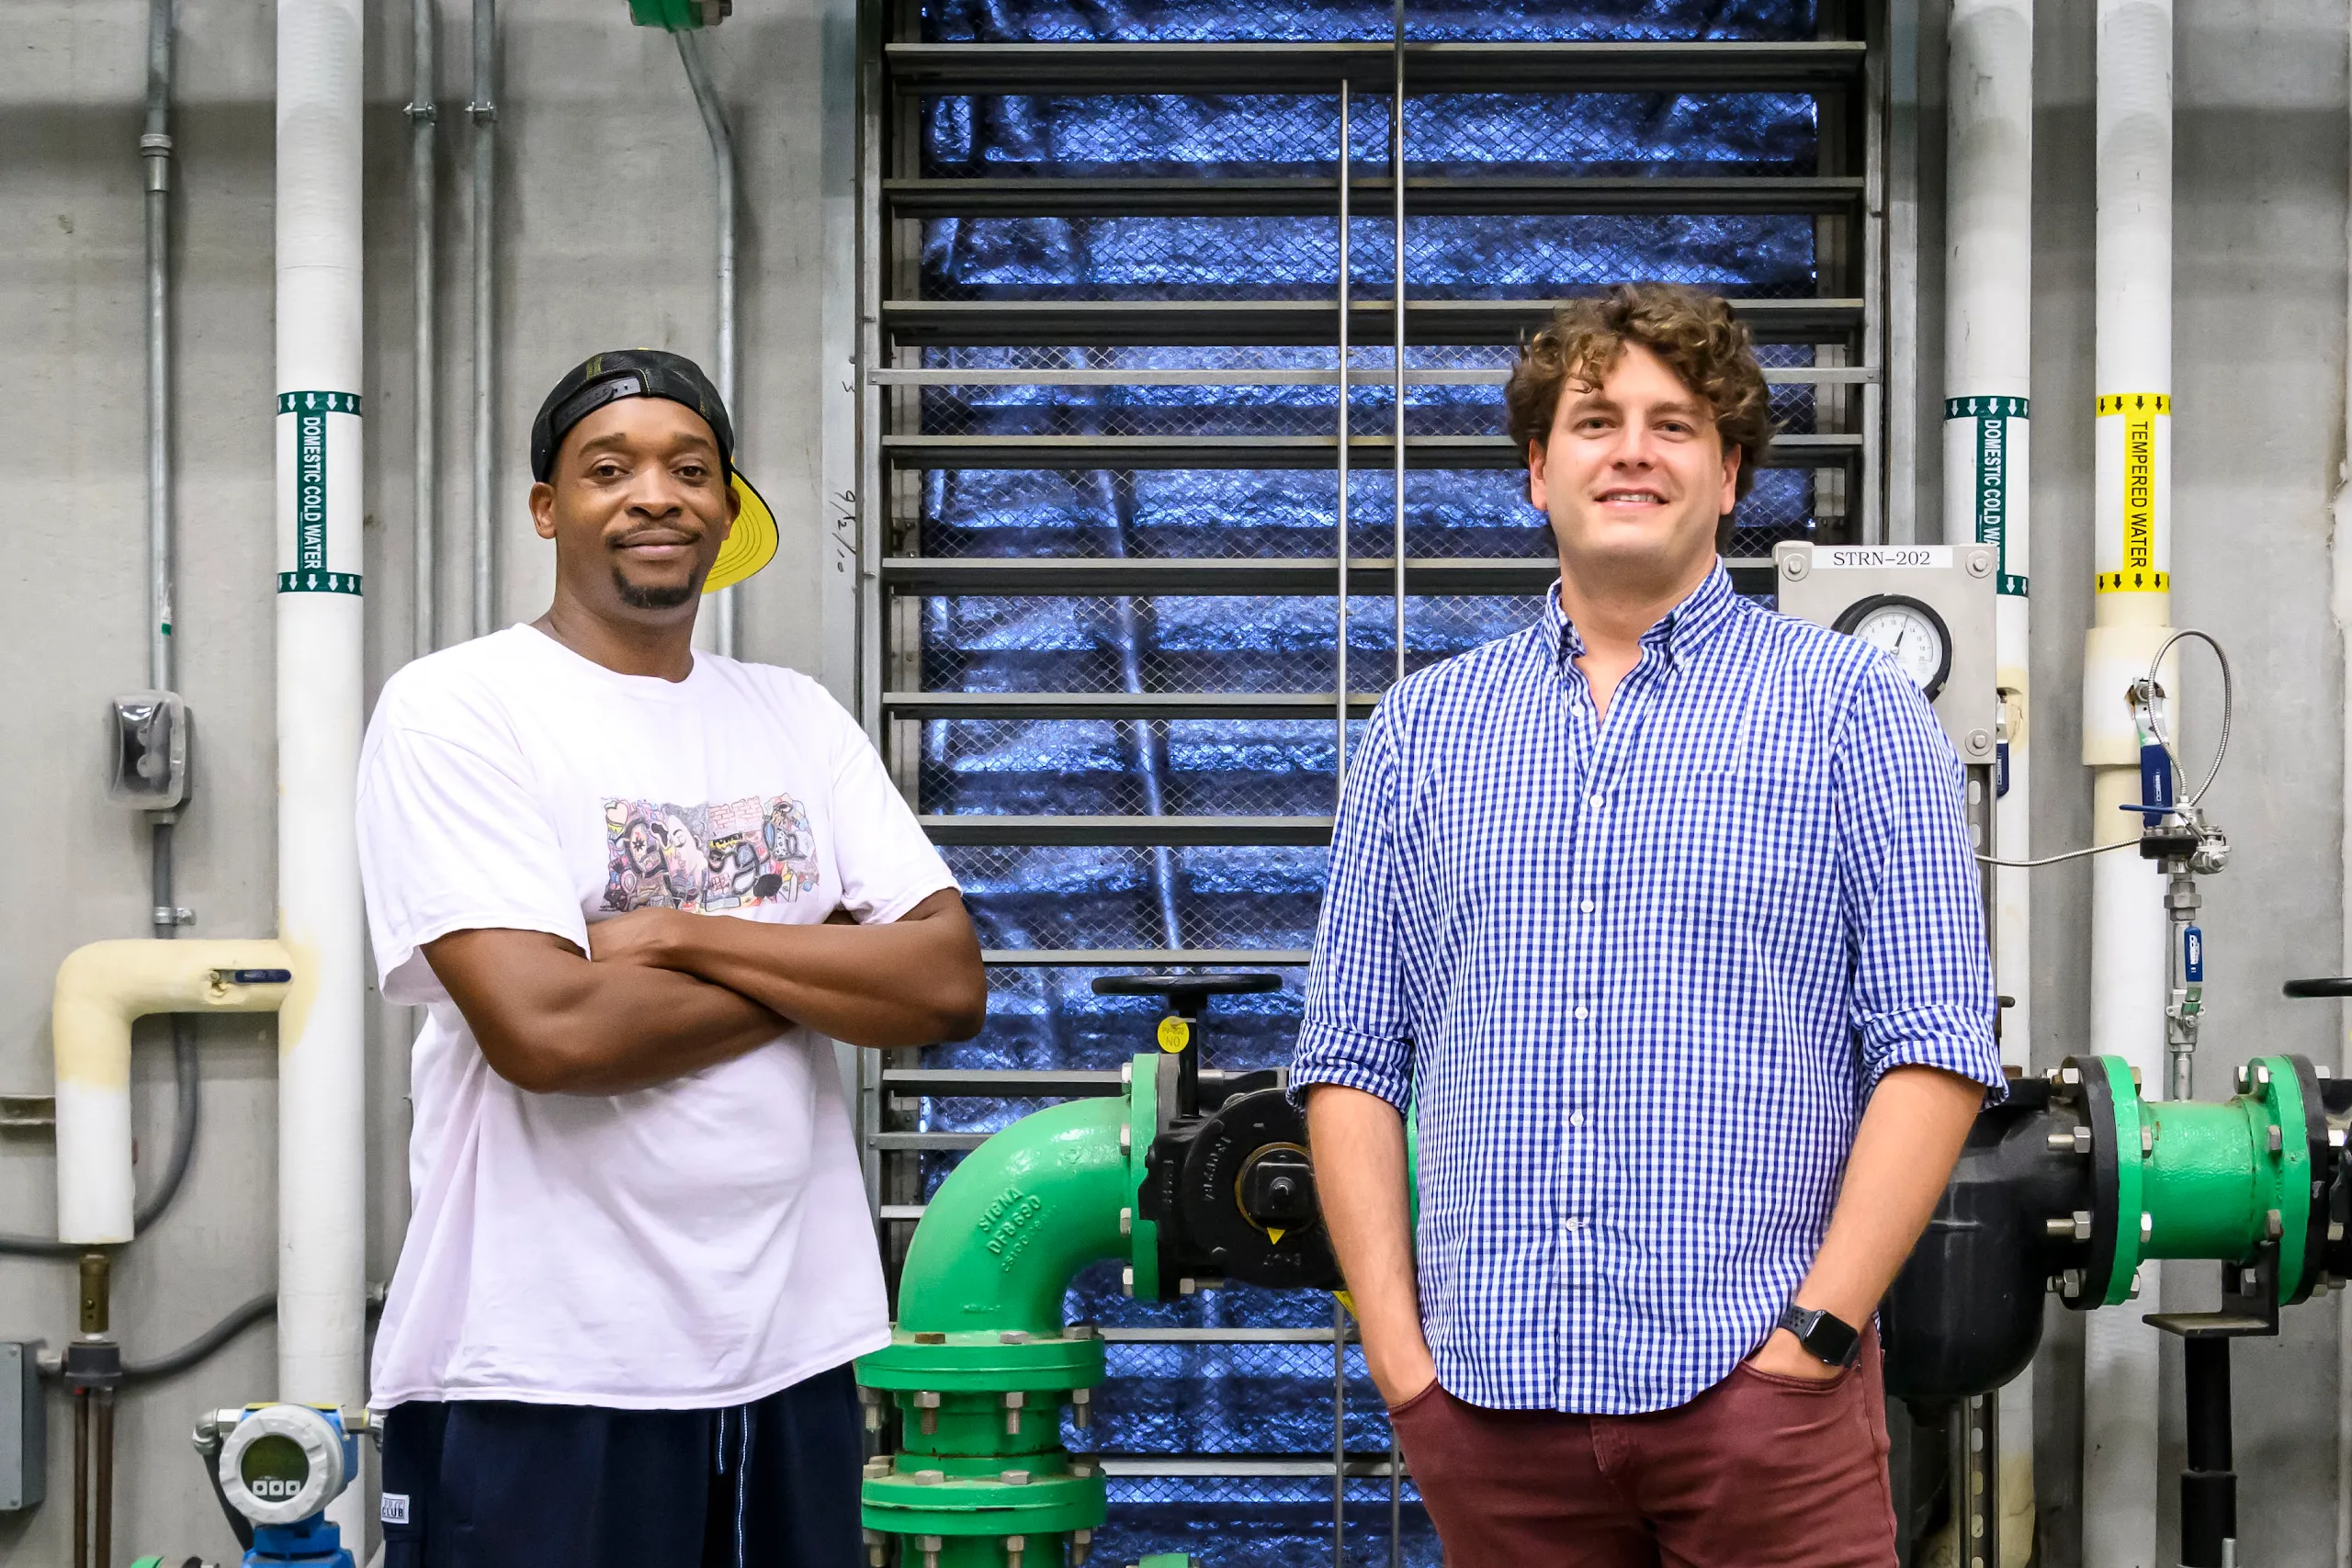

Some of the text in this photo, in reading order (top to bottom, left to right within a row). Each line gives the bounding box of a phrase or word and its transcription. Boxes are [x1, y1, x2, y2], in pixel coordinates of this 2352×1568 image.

[1984, 419, 2002, 486] DOMESTIC
[303, 416, 322, 570] DOMESTIC COLD WATER
[1983, 489, 2001, 525] COLD
[2131, 421, 2148, 568] TEMPERED WATER
[1833, 550, 1930, 566] STRN-202
[1166, 1036, 1181, 1047] NO
[382, 1506, 403, 1517] CLUB
